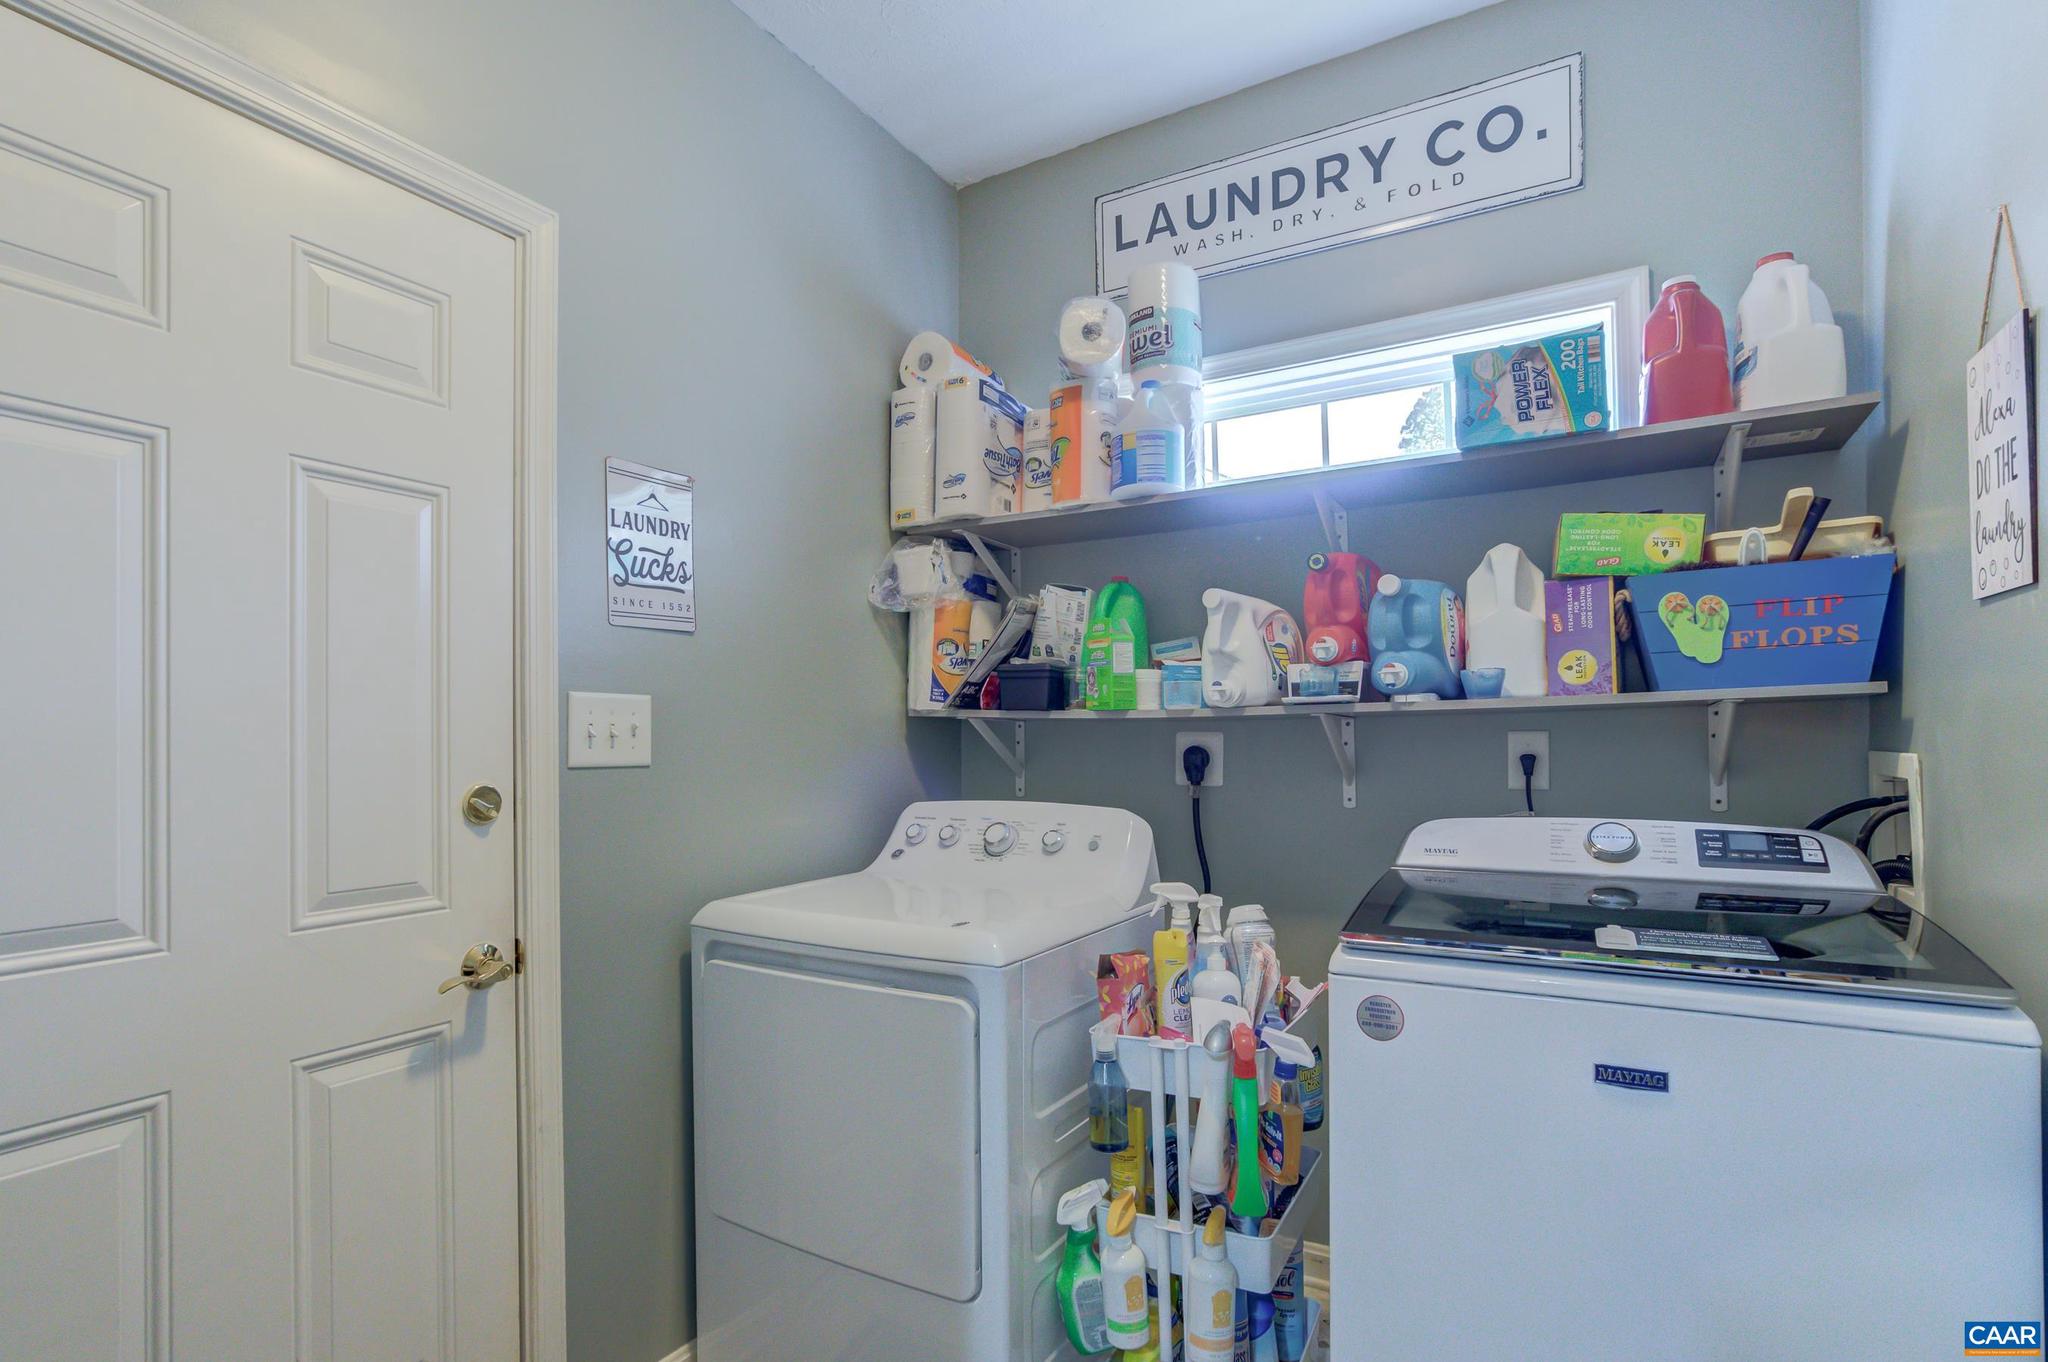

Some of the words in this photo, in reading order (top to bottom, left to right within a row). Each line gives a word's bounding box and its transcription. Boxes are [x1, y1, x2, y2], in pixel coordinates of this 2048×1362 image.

[1115, 136, 1397, 253] LAUNDRY
[1426, 104, 1548, 167] CO.
[1173, 226, 1255, 257] WASH.
[1272, 207, 1336, 233] DRY.
[1354, 196, 1368, 211] &
[1387, 171, 1466, 203] FOLD
[1560, 339, 1576, 371] 200
[1576, 355, 1585, 381] Kitchen
[1511, 359, 1535, 423] POWER
[1531, 364, 1554, 412] FLEX
[1974, 387, 2016, 442] Alexa
[1976, 454, 1991, 500] DO
[1994, 436, 2019, 489] THE
[610, 508, 691, 541] LAUNDRY
[1652, 540, 1681, 548] LEAK
[1974, 499, 2027, 563] laundry
[607, 537, 693, 592] Sucks
[612, 597, 654, 609] SINCE
[662, 602, 692, 613] 1552
[1755, 594, 1845, 619] FLIP
[1446, 597, 1457, 657] Downy
[1730, 624, 1861, 650] FLOPS
[1575, 655, 1583, 679] LEAK
[1598, 1067, 1666, 1088] MAYTAG
